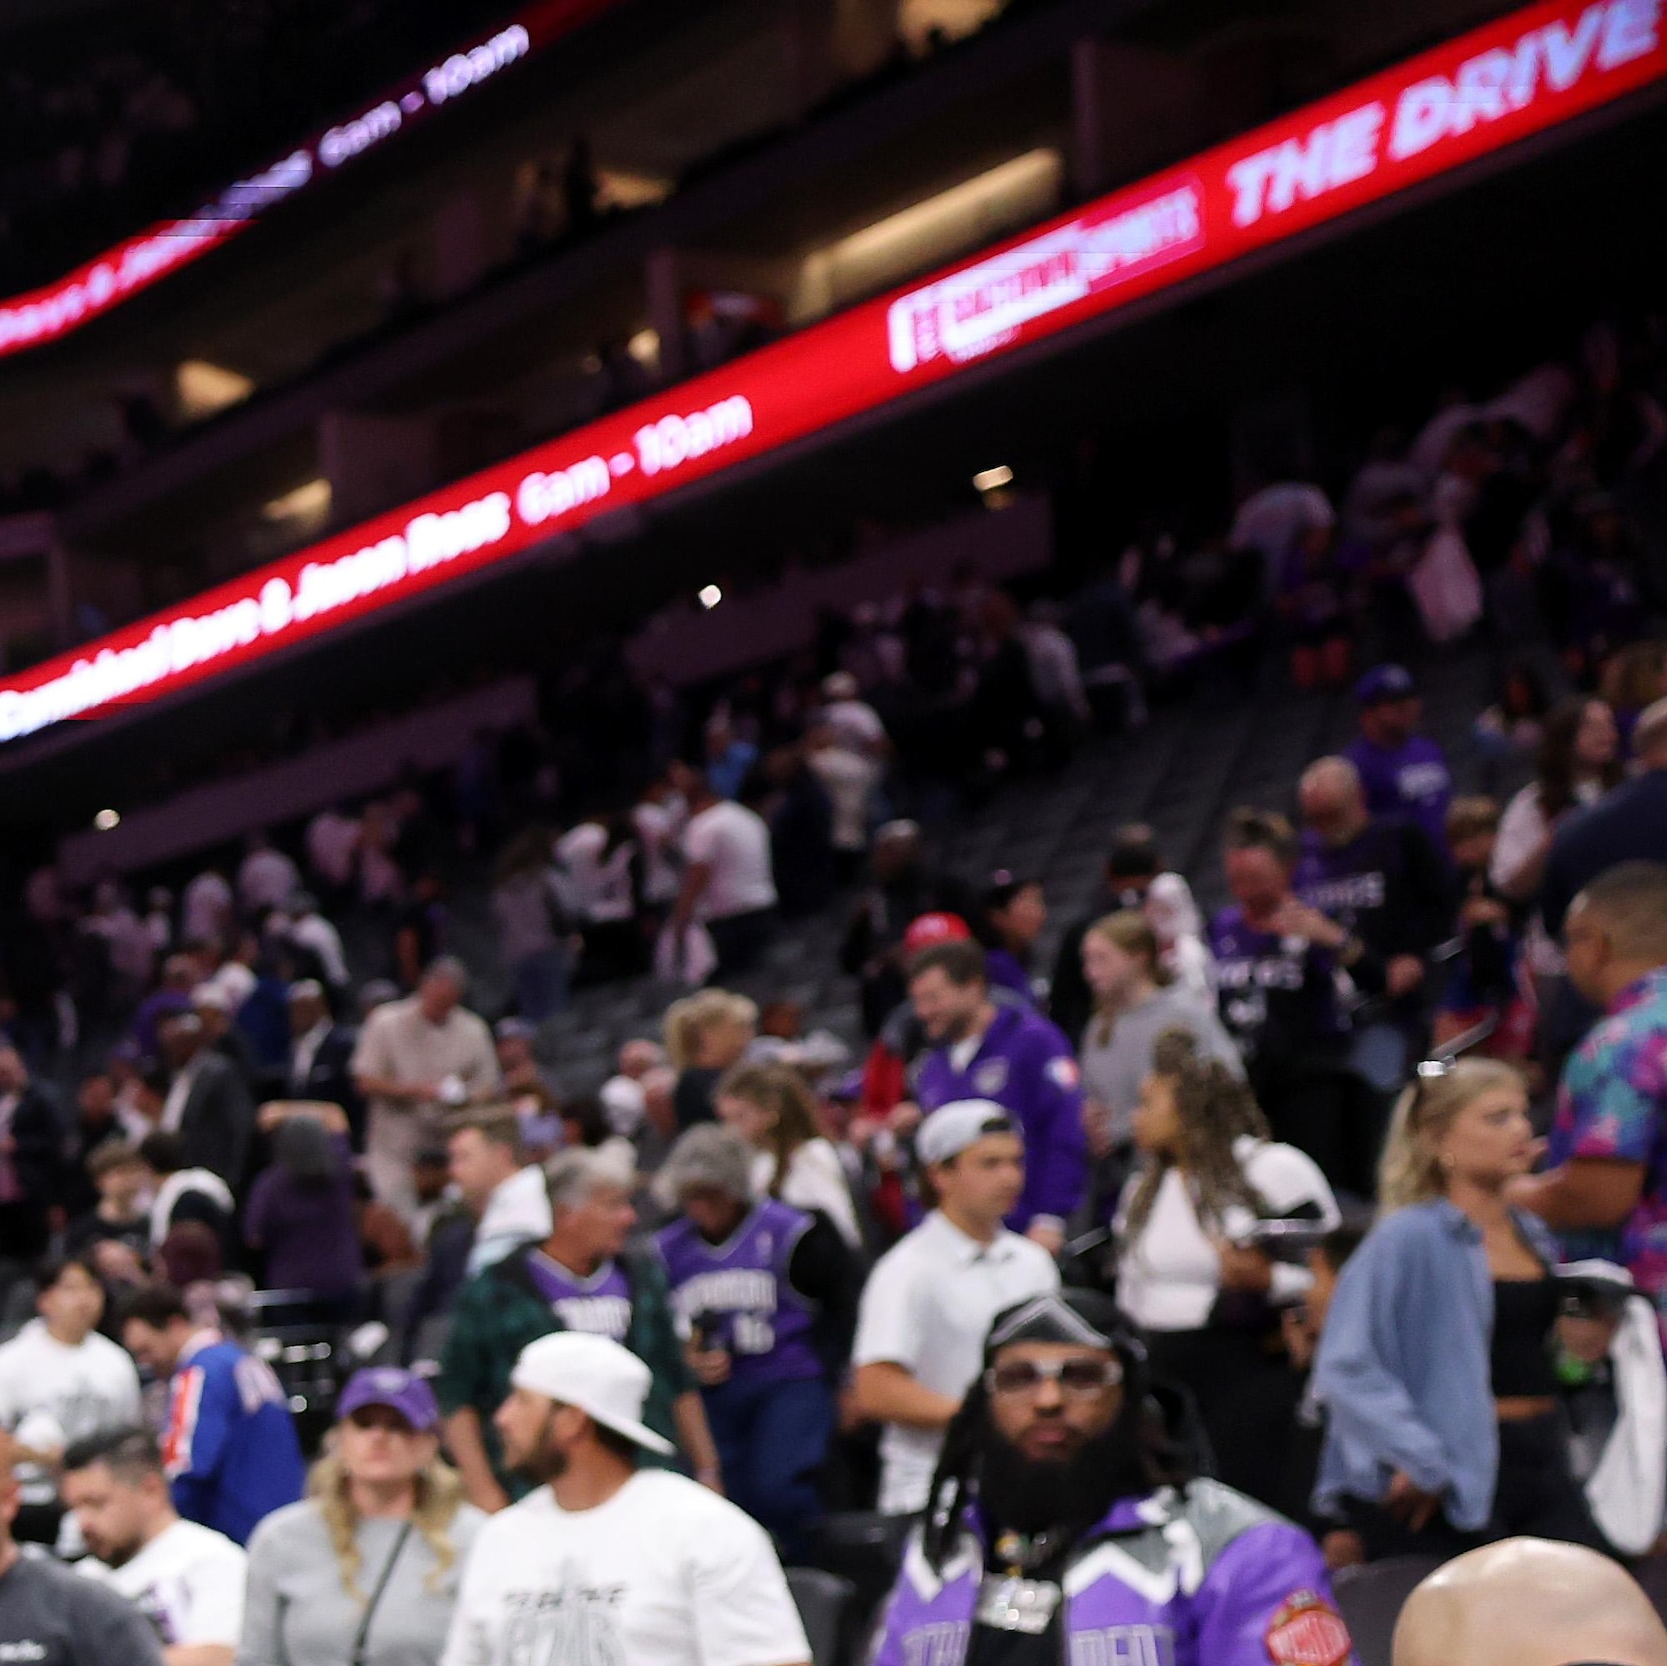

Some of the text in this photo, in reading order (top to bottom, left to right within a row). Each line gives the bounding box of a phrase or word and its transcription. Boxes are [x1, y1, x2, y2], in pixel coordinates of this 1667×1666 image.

[1226, 0, 1660, 228] THE DRIVE
[516, 455, 611, 525] 6am
[632, 395, 753, 477] 10am
